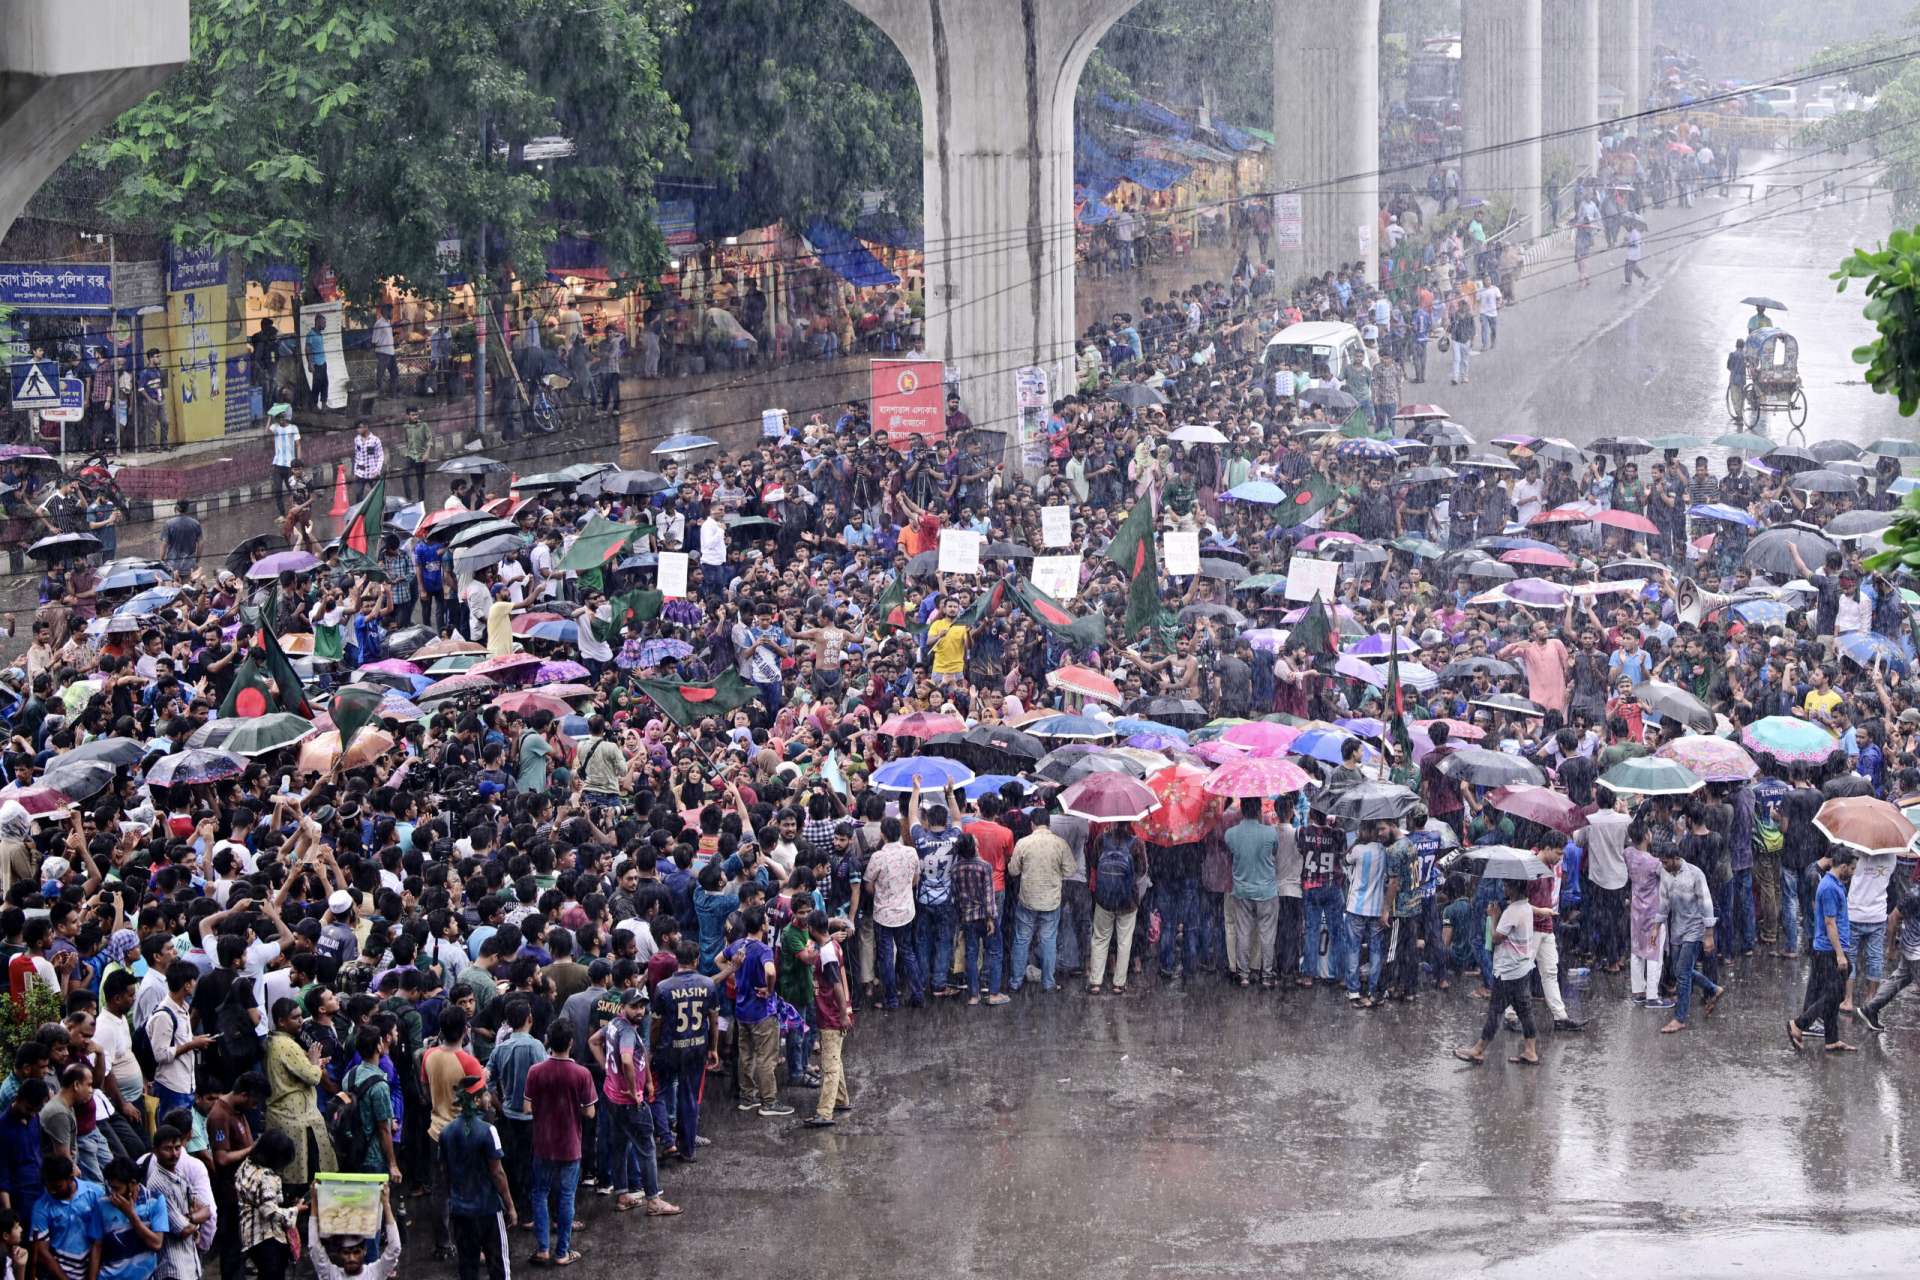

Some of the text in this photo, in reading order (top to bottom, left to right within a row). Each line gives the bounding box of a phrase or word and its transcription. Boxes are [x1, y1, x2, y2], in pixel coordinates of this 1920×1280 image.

[22, 271, 54, 288] ট্রাফিক
[57, 271, 84, 289] পুলিশ
[87, 275, 105, 288] বক্স
[1305, 850, 1335, 873] 49
[671, 987, 707, 999] NASIM
[676, 1001, 704, 1033] 55
